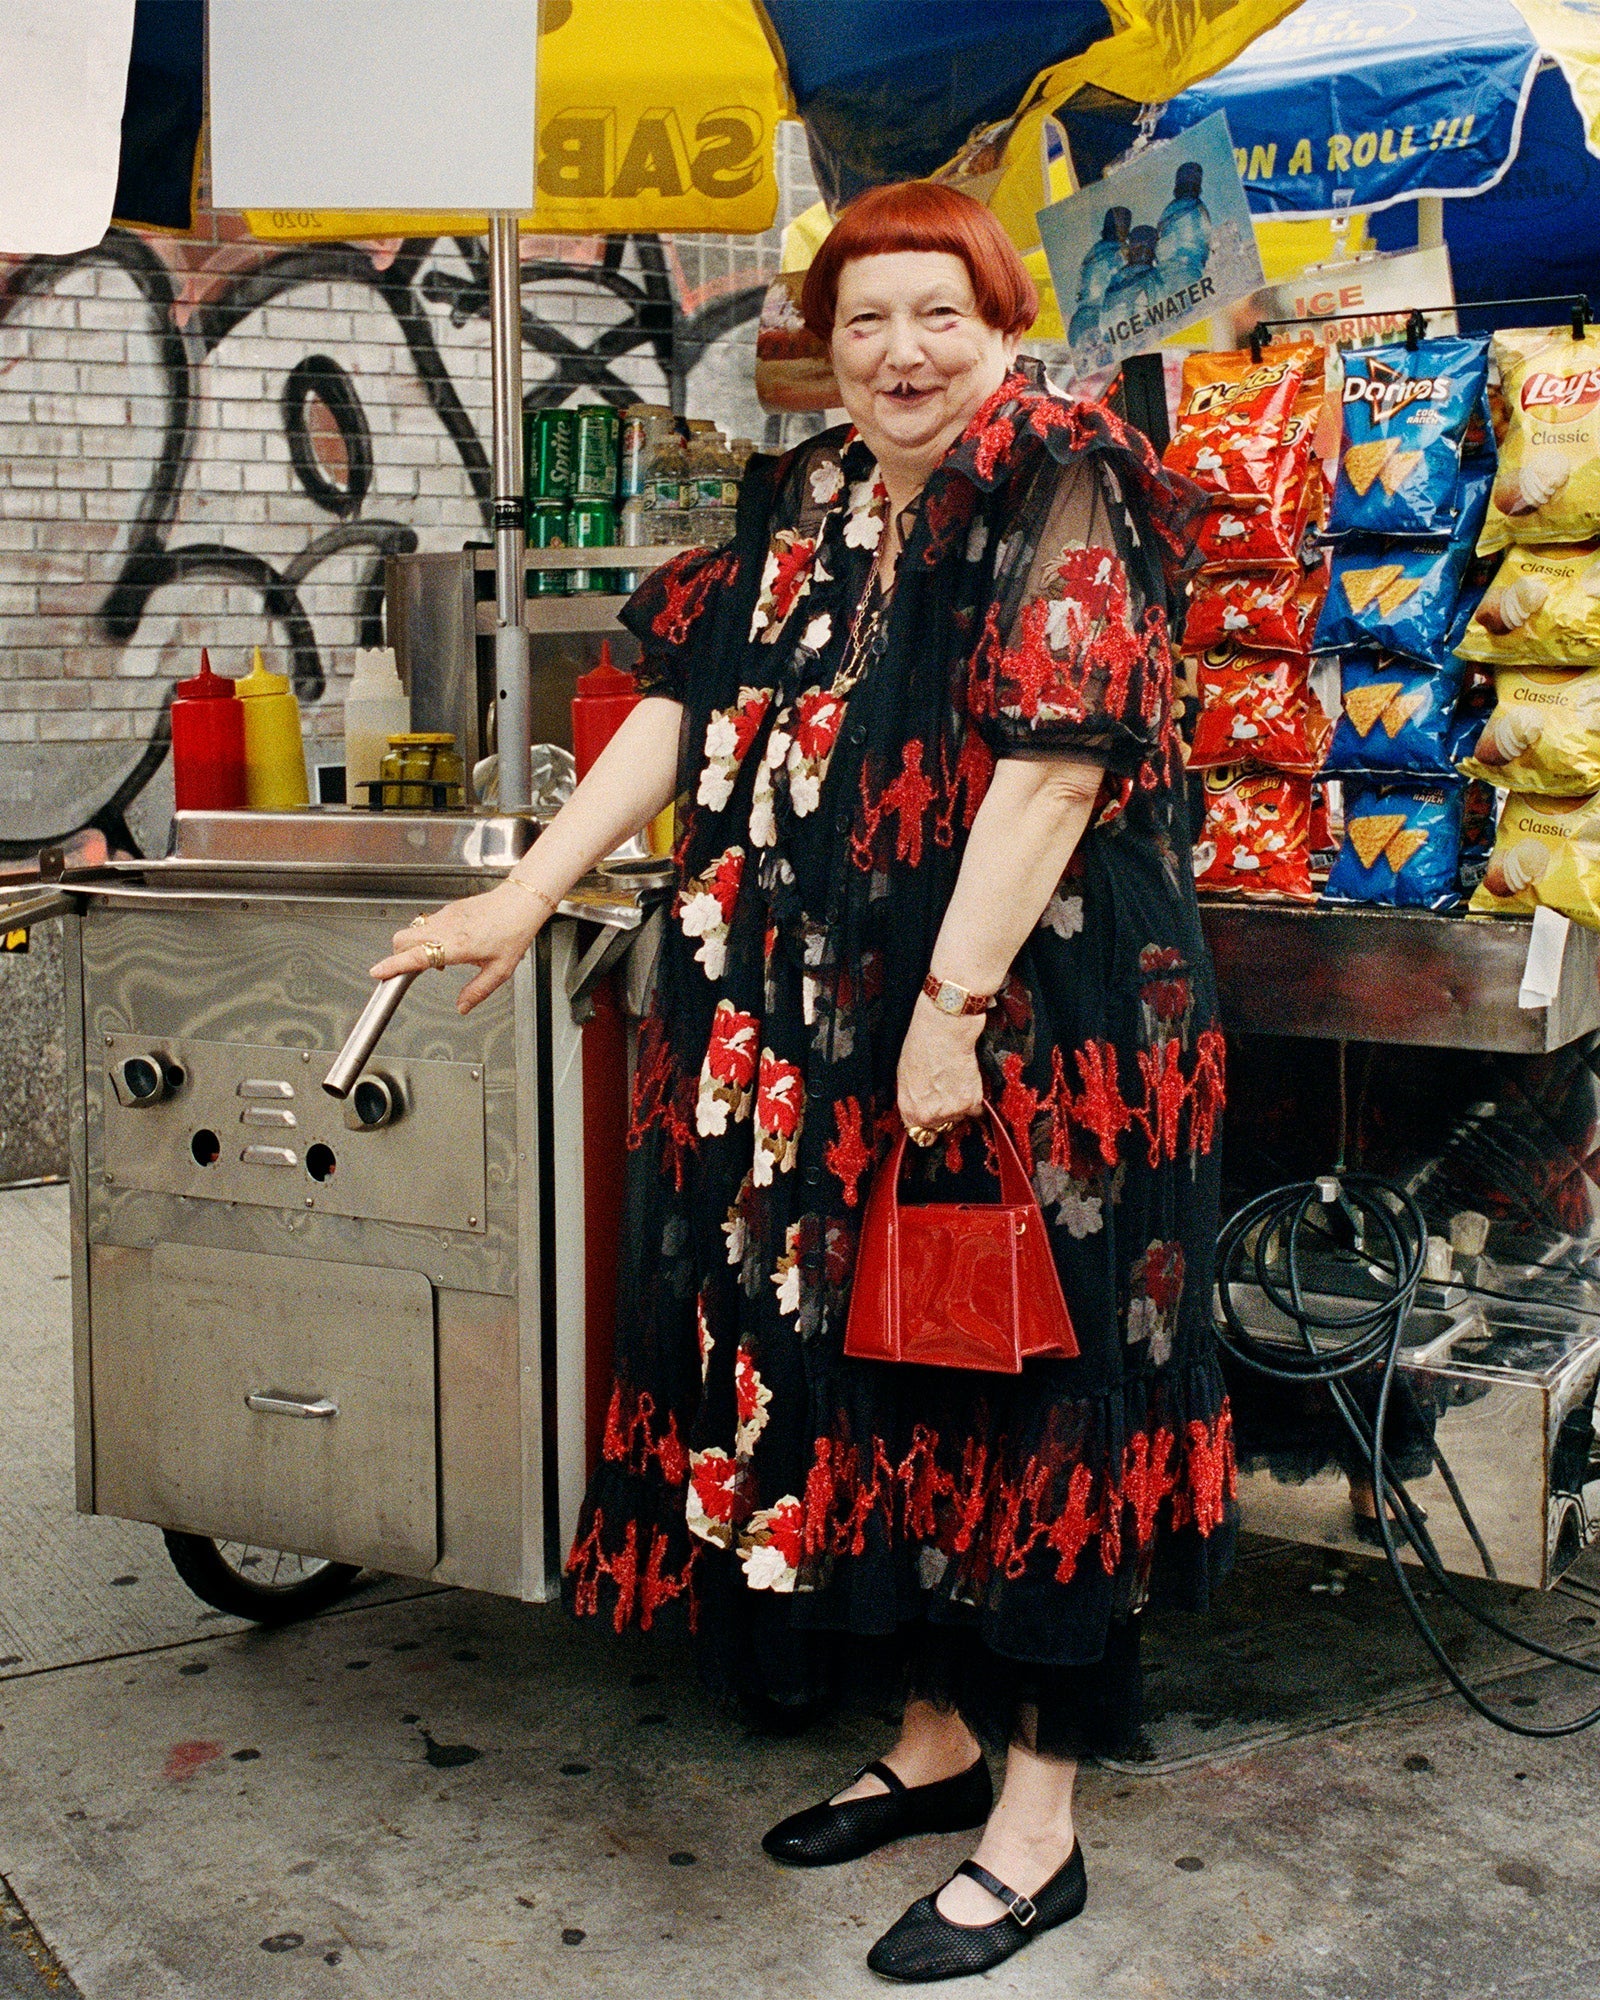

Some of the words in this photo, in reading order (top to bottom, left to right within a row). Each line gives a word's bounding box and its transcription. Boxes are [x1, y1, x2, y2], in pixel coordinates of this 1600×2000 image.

[1287, 138, 1312, 177] A
[1326, 125, 1417, 173] ROLL
[1107, 313, 1145, 345] ICE
[1145, 277, 1217, 326] WATER
[1295, 284, 1365, 318] ICE
[1342, 377, 1450, 403] Doritos
[1531, 430, 1590, 446] Classic
[550, 421, 571, 482] Sprite
[1520, 562, 1575, 578] Classic
[1513, 687, 1569, 706] Classic
[1518, 817, 1572, 837] Classic
